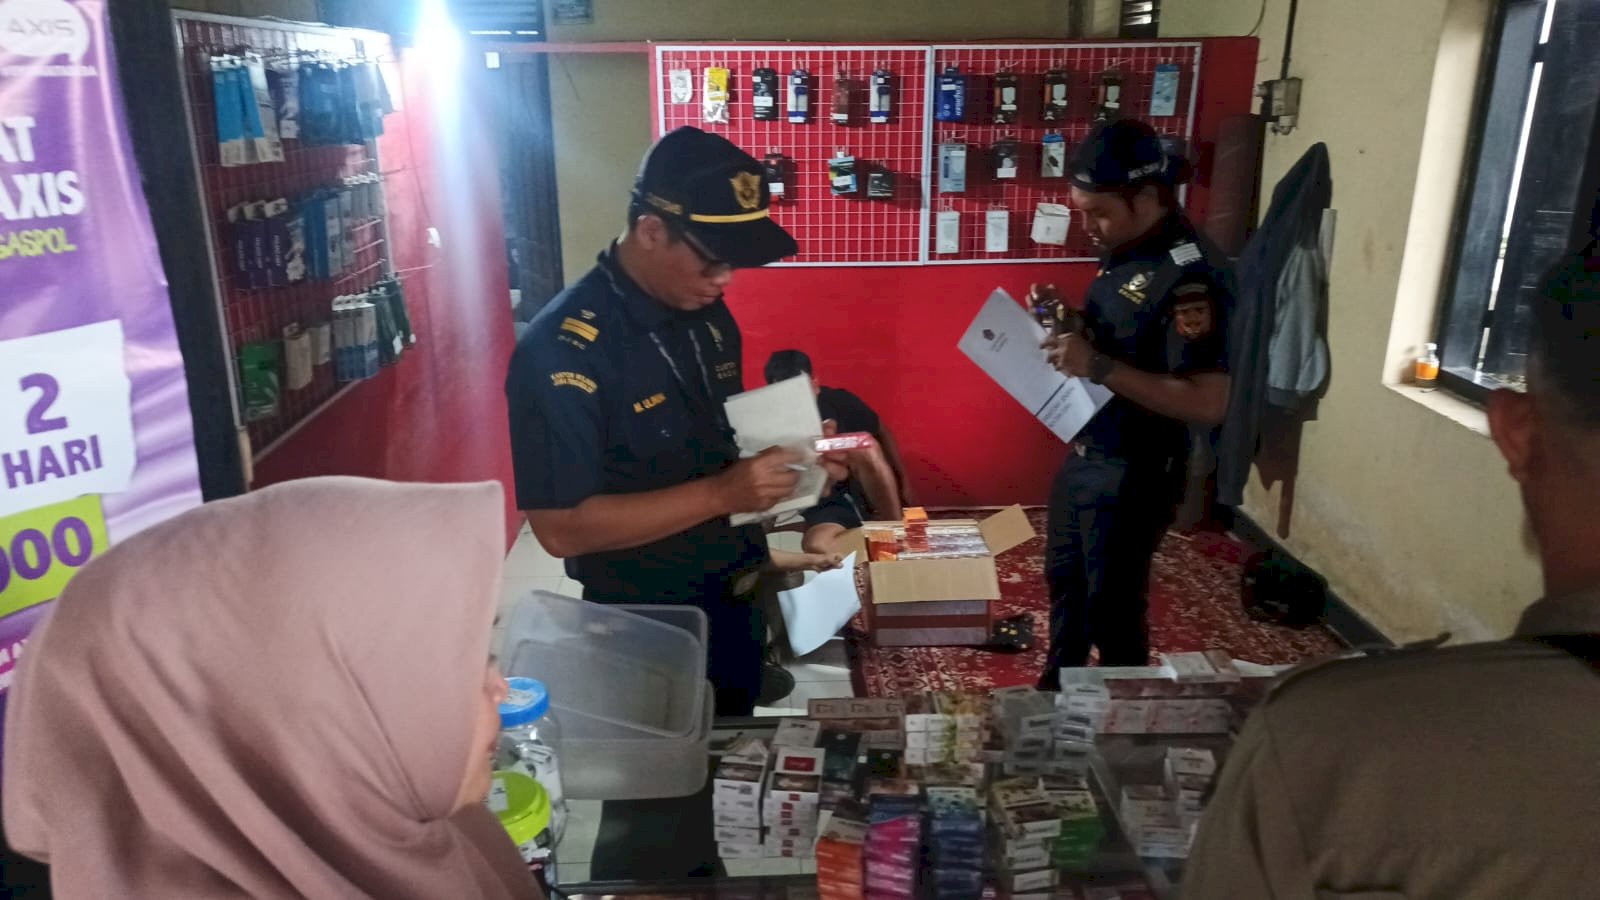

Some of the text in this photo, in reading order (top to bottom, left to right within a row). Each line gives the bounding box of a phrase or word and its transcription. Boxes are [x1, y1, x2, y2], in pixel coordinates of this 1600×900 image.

[8, 17, 75, 37] AXIS
[19, 372, 68, 435] 2
[3, 434, 103, 489] HARI
[0, 516, 94, 594] 00
